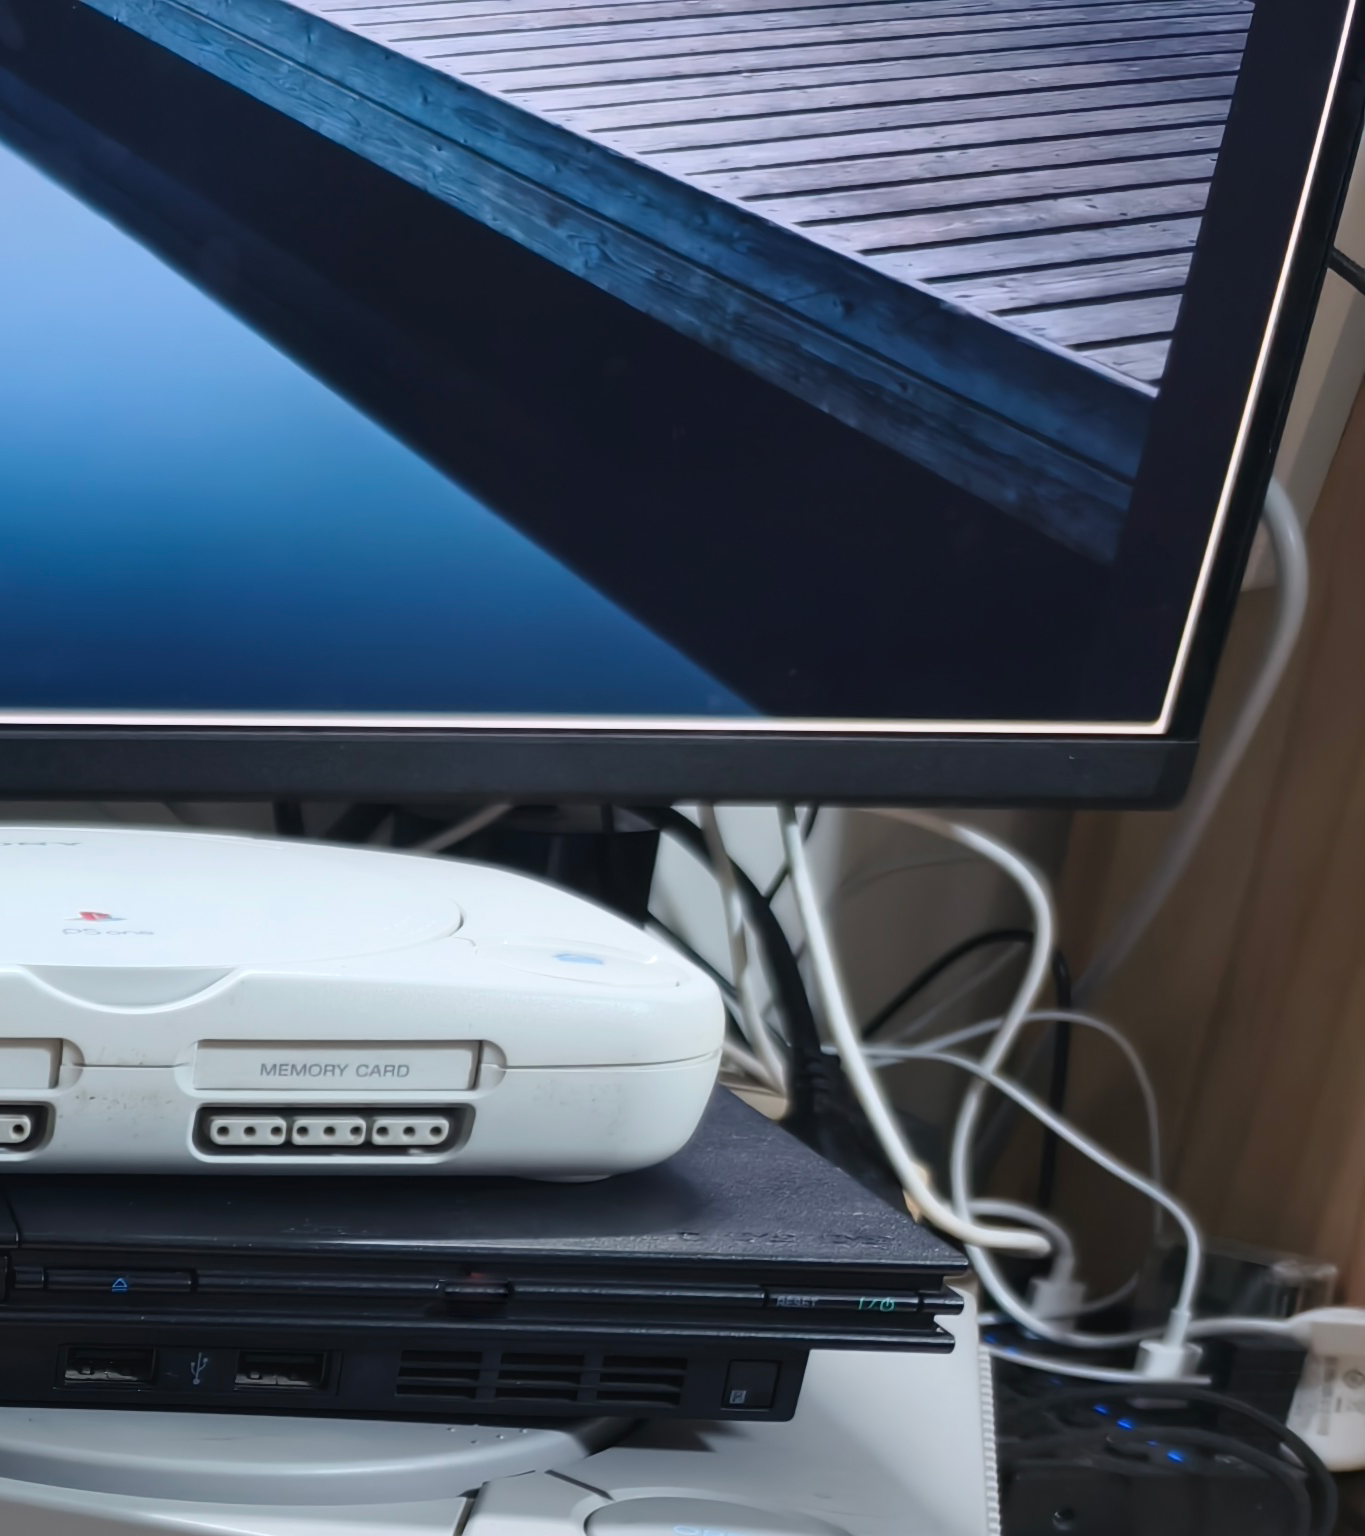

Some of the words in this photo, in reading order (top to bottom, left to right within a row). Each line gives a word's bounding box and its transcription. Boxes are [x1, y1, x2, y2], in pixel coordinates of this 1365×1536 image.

[259, 1062, 349, 1078] MEMORY
[355, 1064, 410, 1078] CARD
[776, 1295, 819, 1308] RESET
